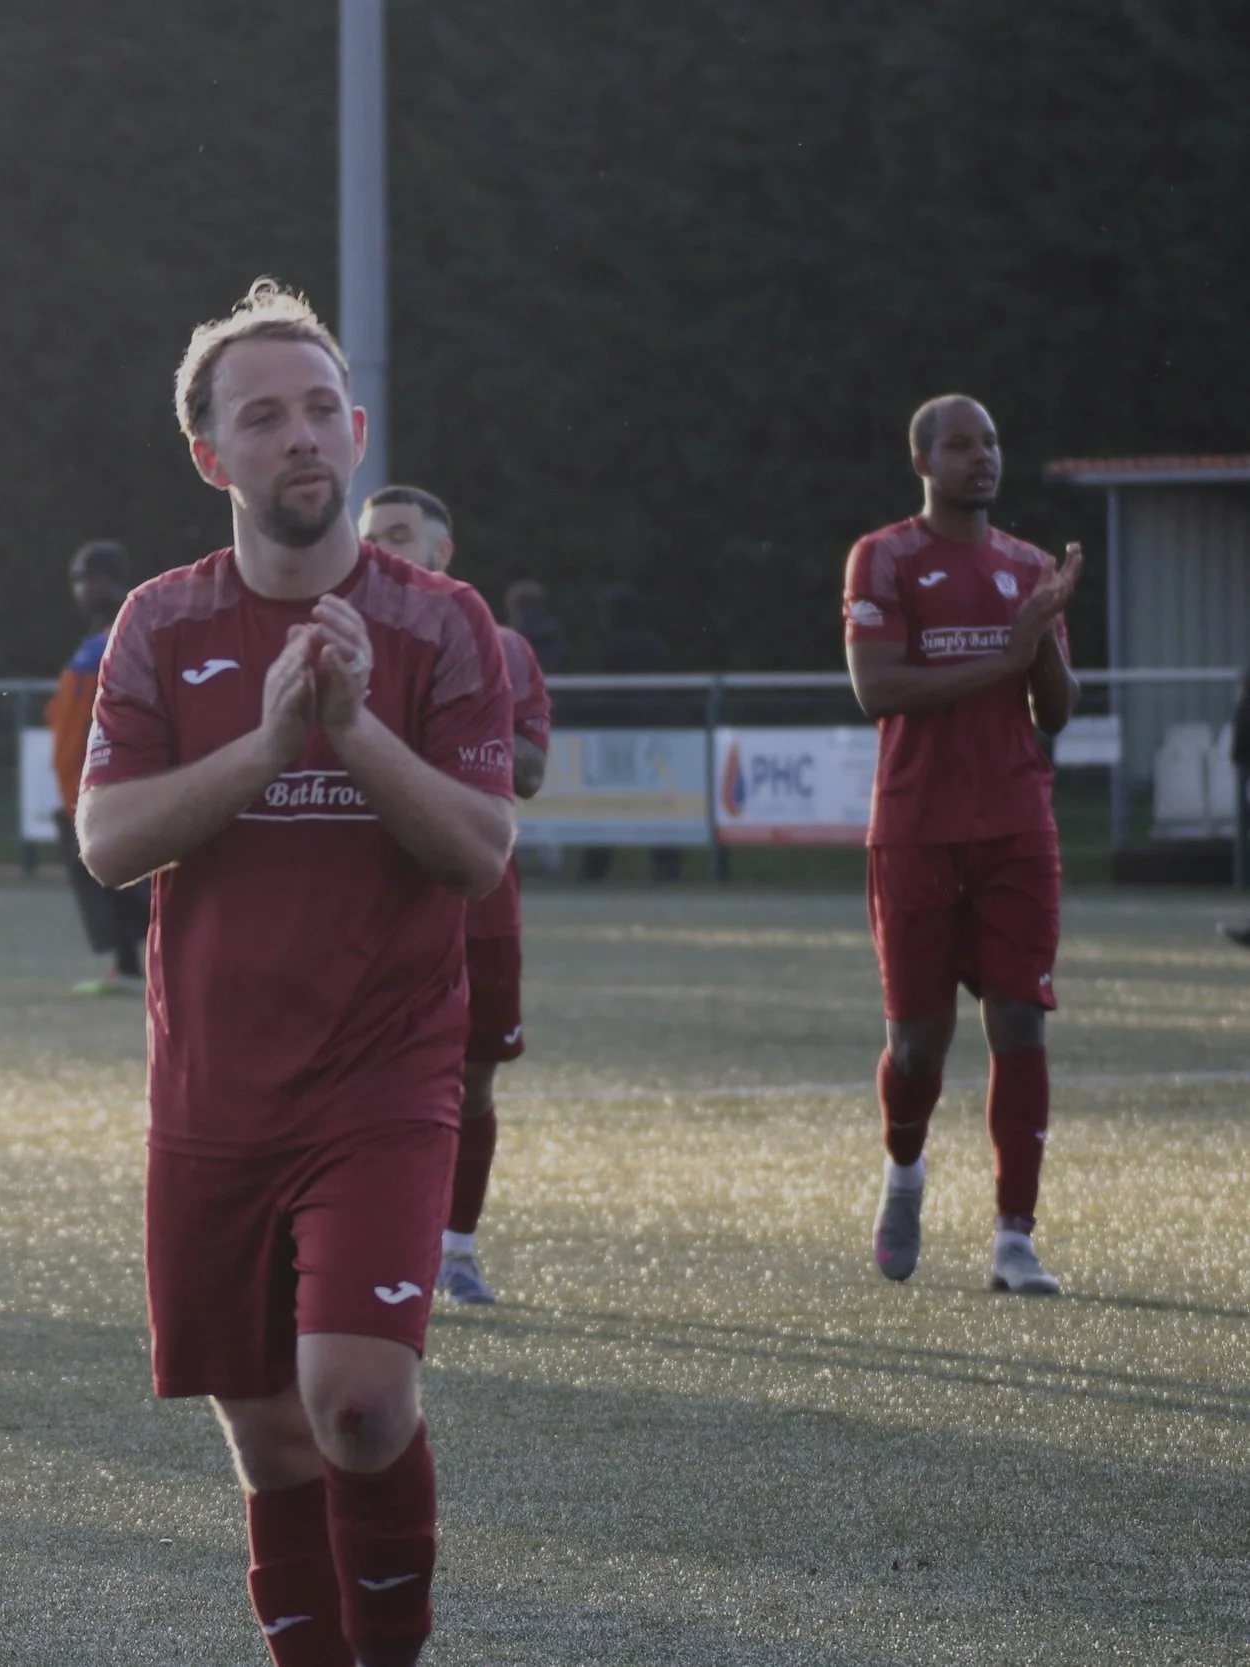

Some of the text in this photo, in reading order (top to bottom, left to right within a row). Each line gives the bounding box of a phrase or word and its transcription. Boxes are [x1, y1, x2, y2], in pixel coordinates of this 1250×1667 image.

[920, 629, 966, 653] Simply
[457, 746, 508, 768] WILK
[751, 753, 814, 798] PHC
